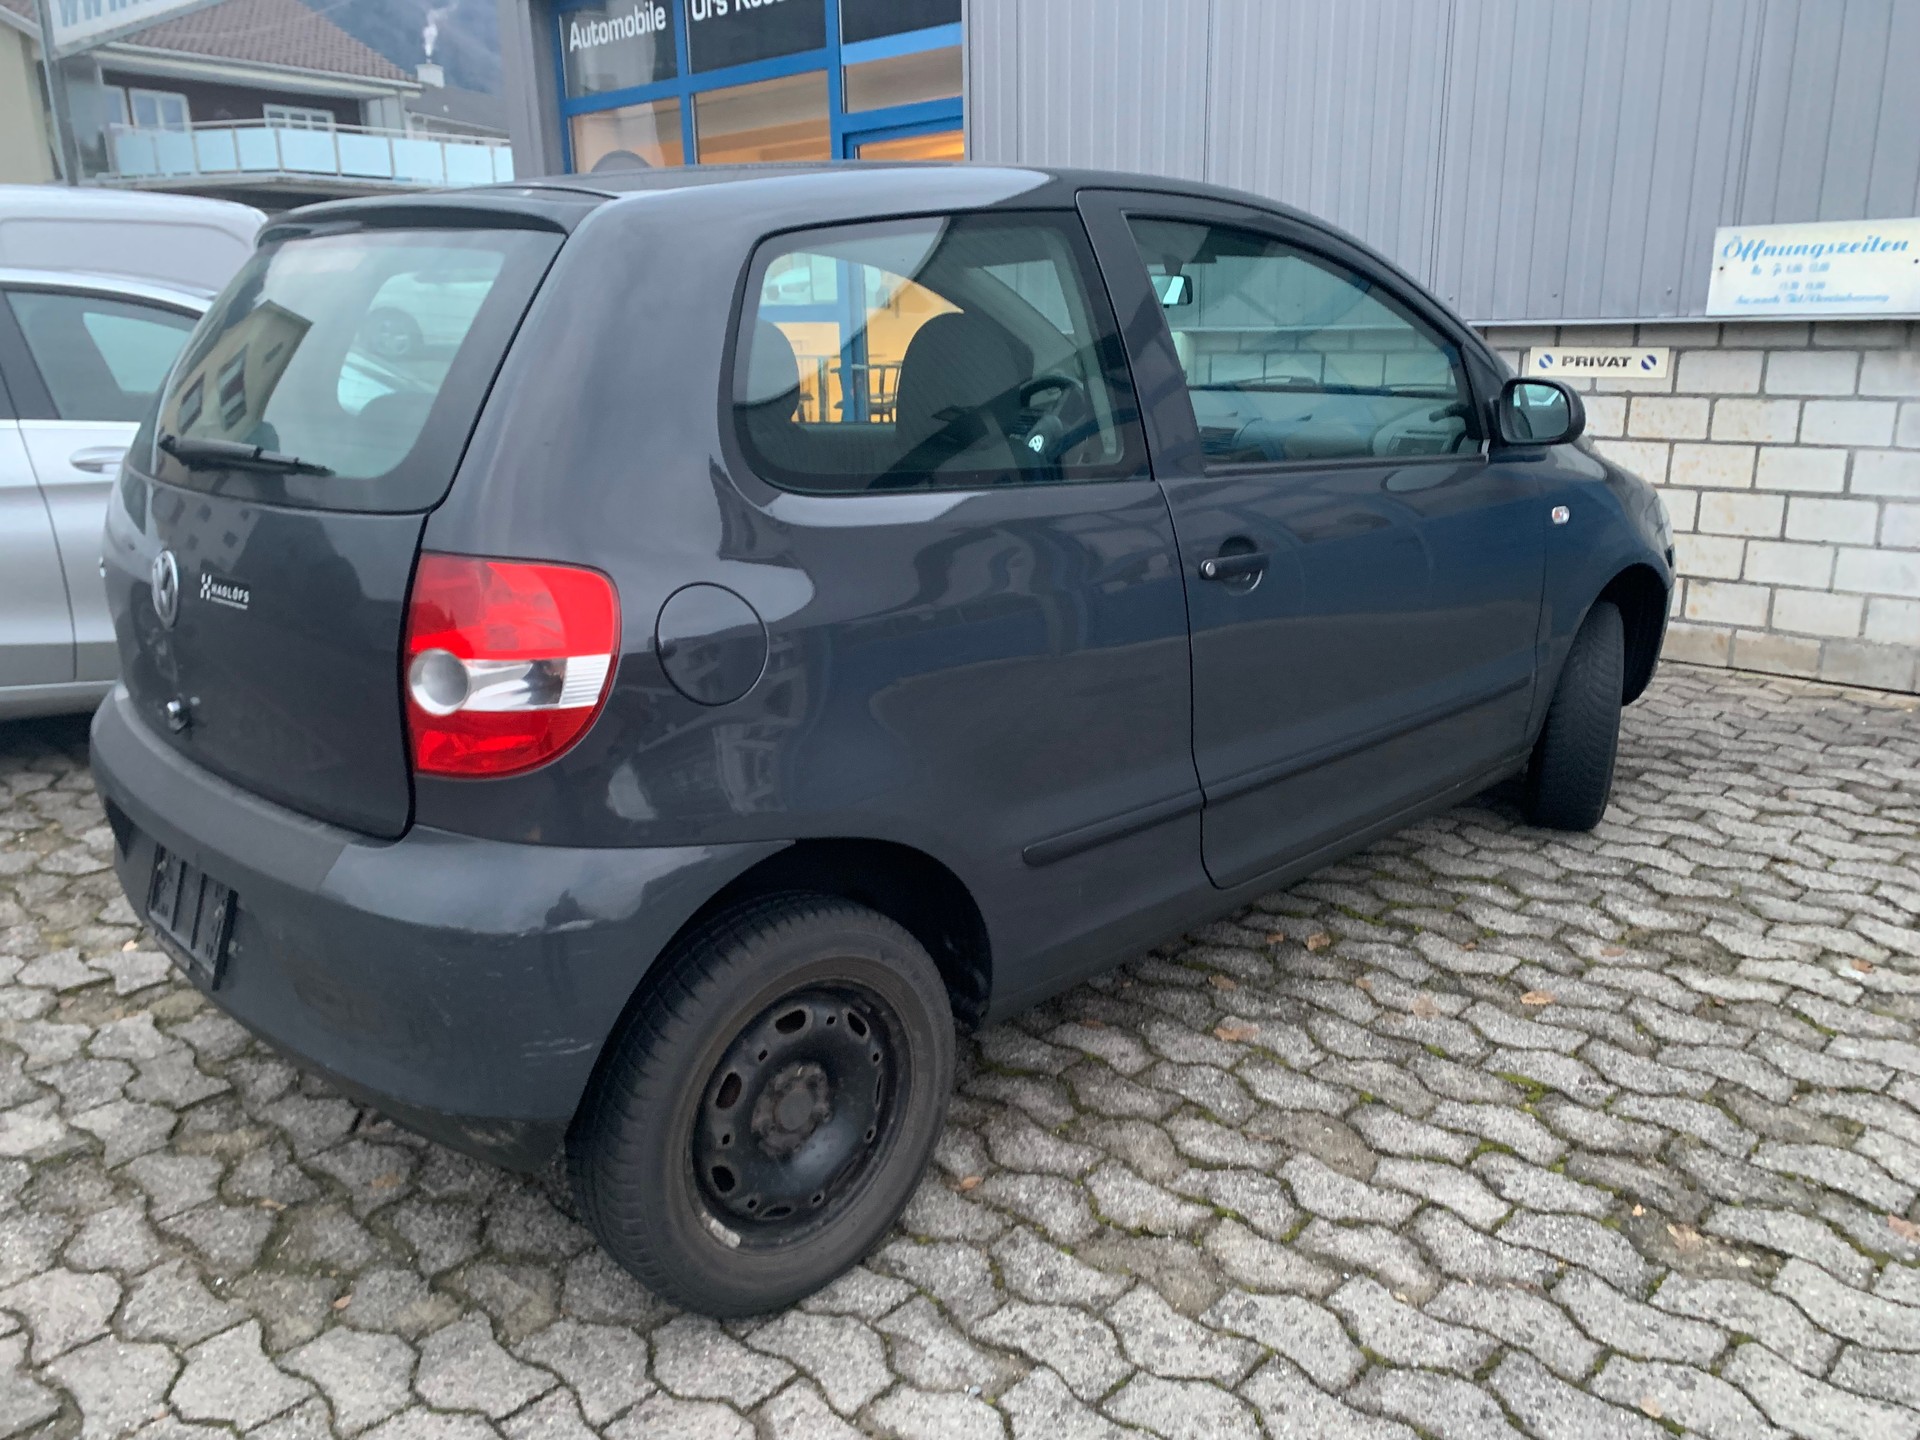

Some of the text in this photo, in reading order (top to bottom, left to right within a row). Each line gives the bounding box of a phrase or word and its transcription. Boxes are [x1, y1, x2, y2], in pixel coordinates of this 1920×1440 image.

[569, 0, 667, 53] Automobile
[1722, 235, 1909, 263] Öffnungszeiten
[1561, 355, 1632, 368] PRIVAT
